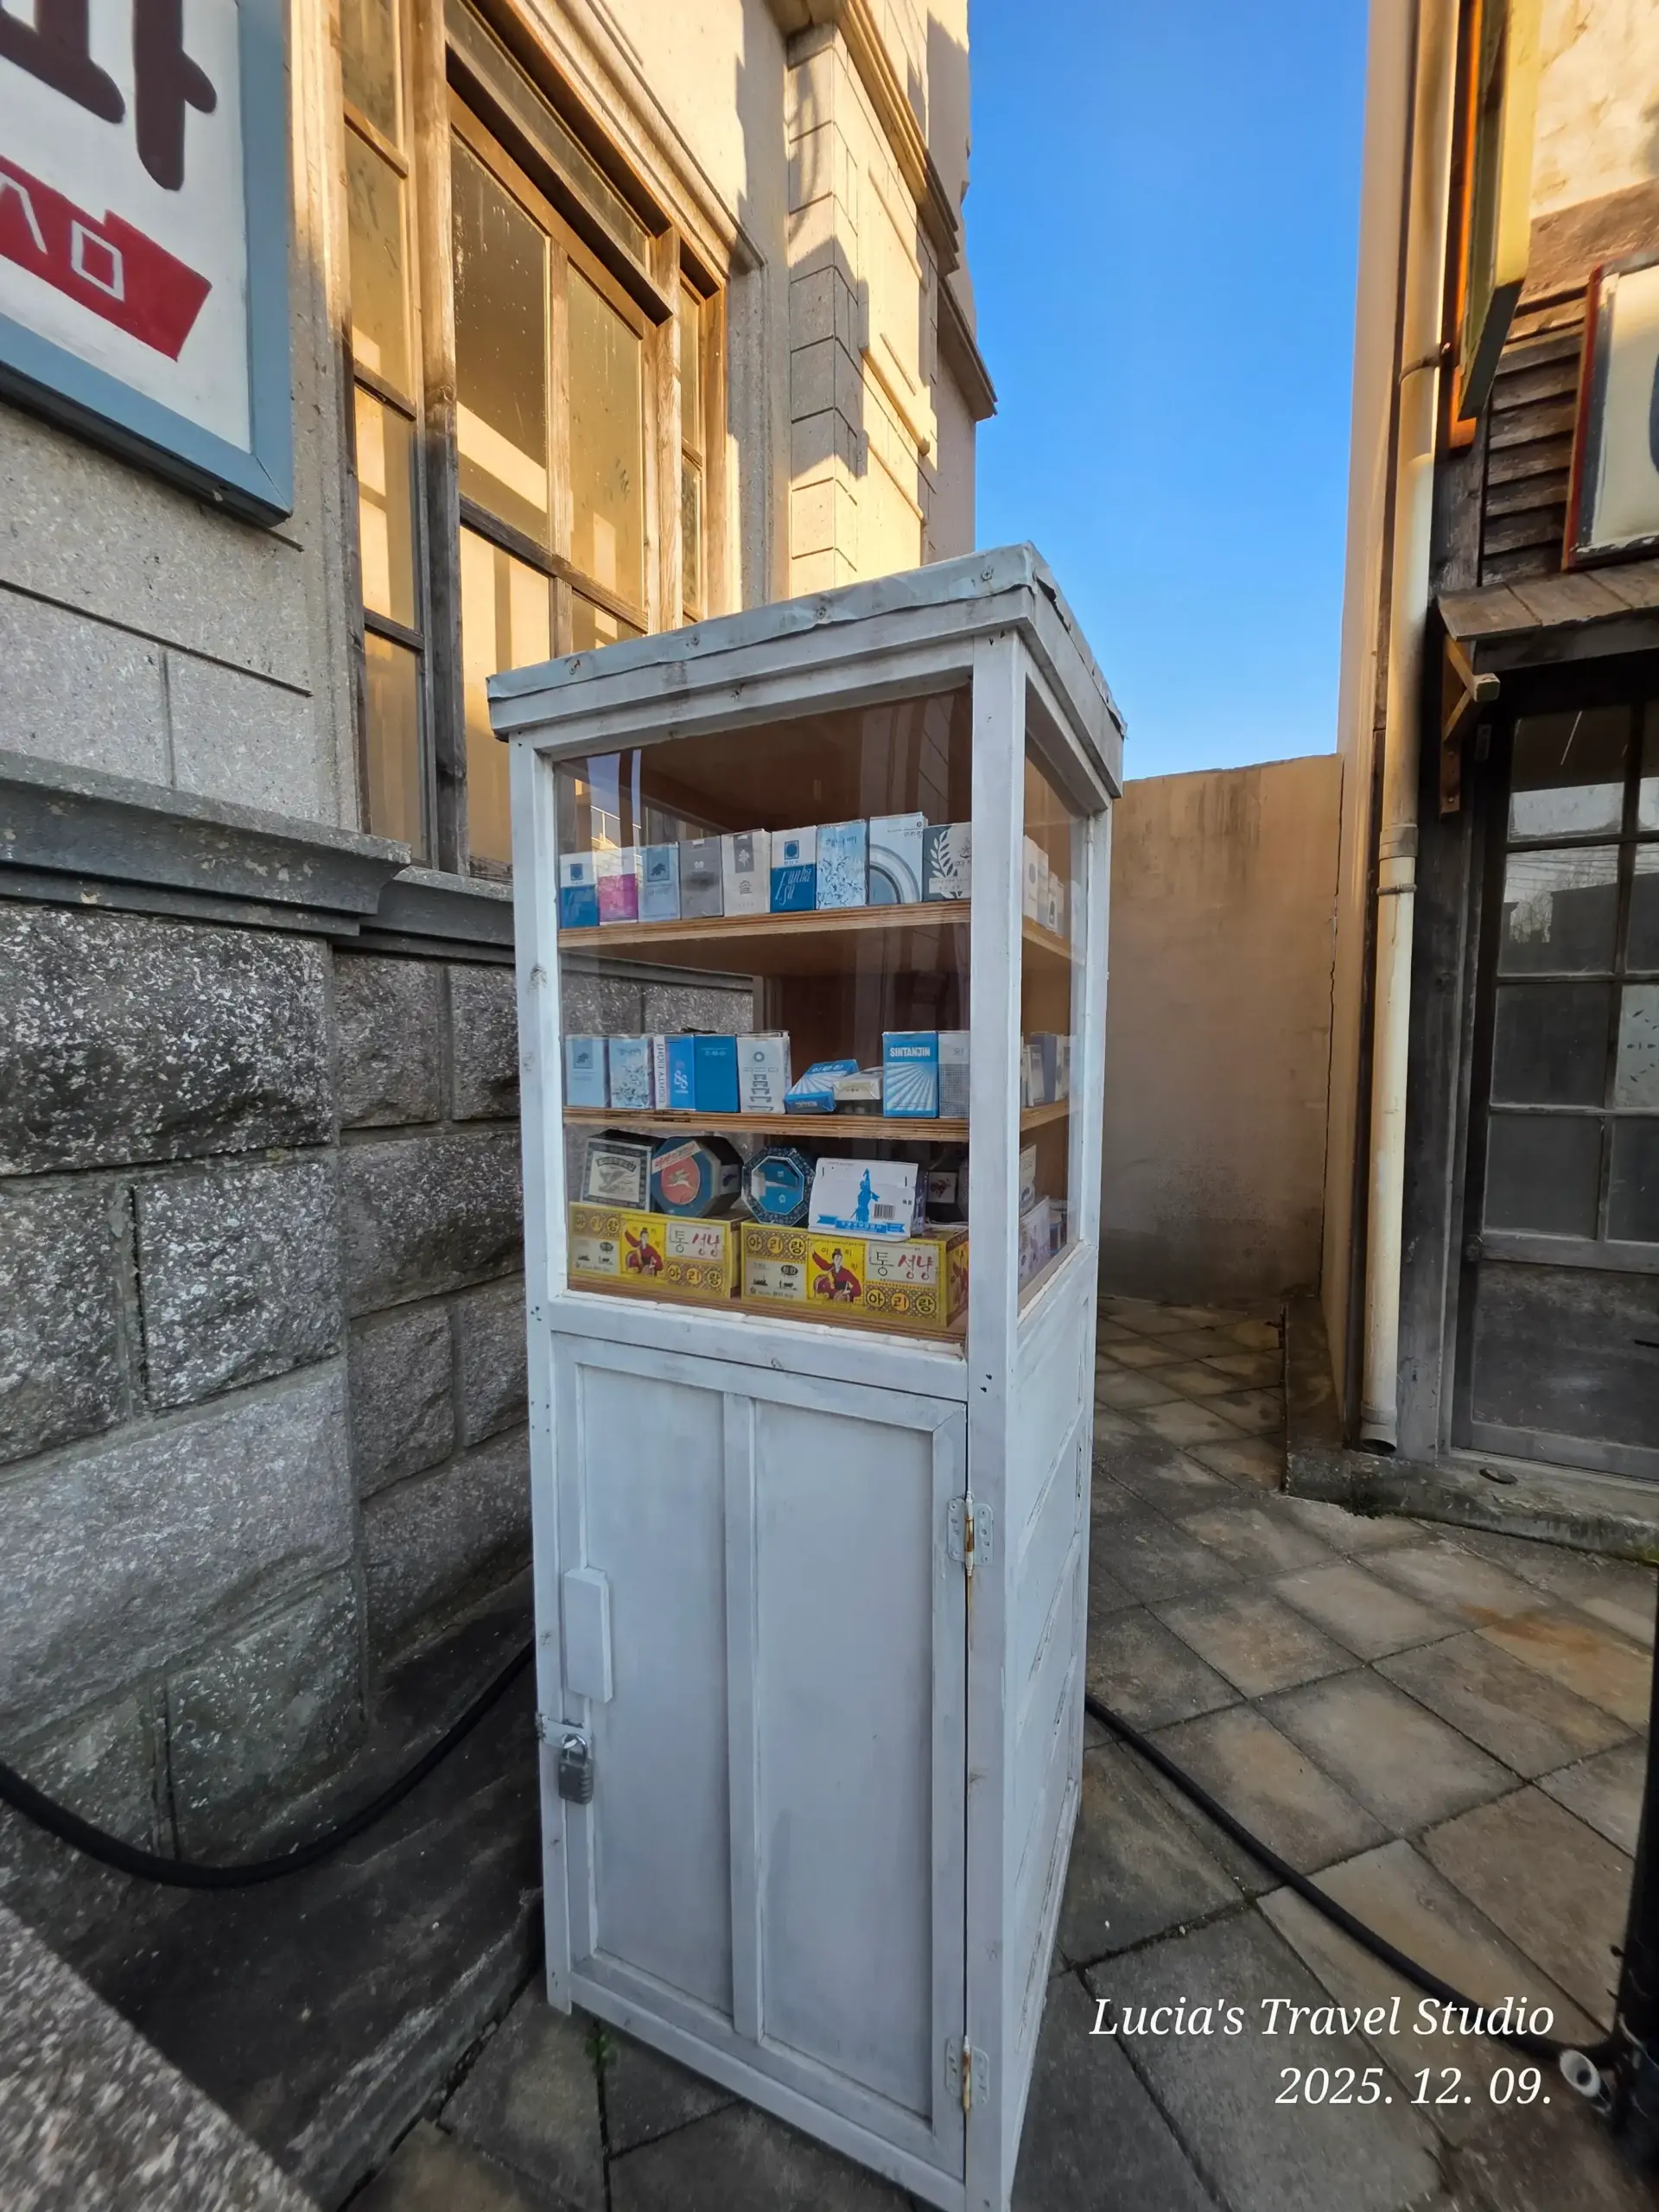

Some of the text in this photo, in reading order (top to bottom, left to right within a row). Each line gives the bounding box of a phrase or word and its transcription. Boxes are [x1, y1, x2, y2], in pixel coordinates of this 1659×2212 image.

[869, 1250, 933, 1281] 통 성냥
[868, 1293, 933, 1312] 아리랑
